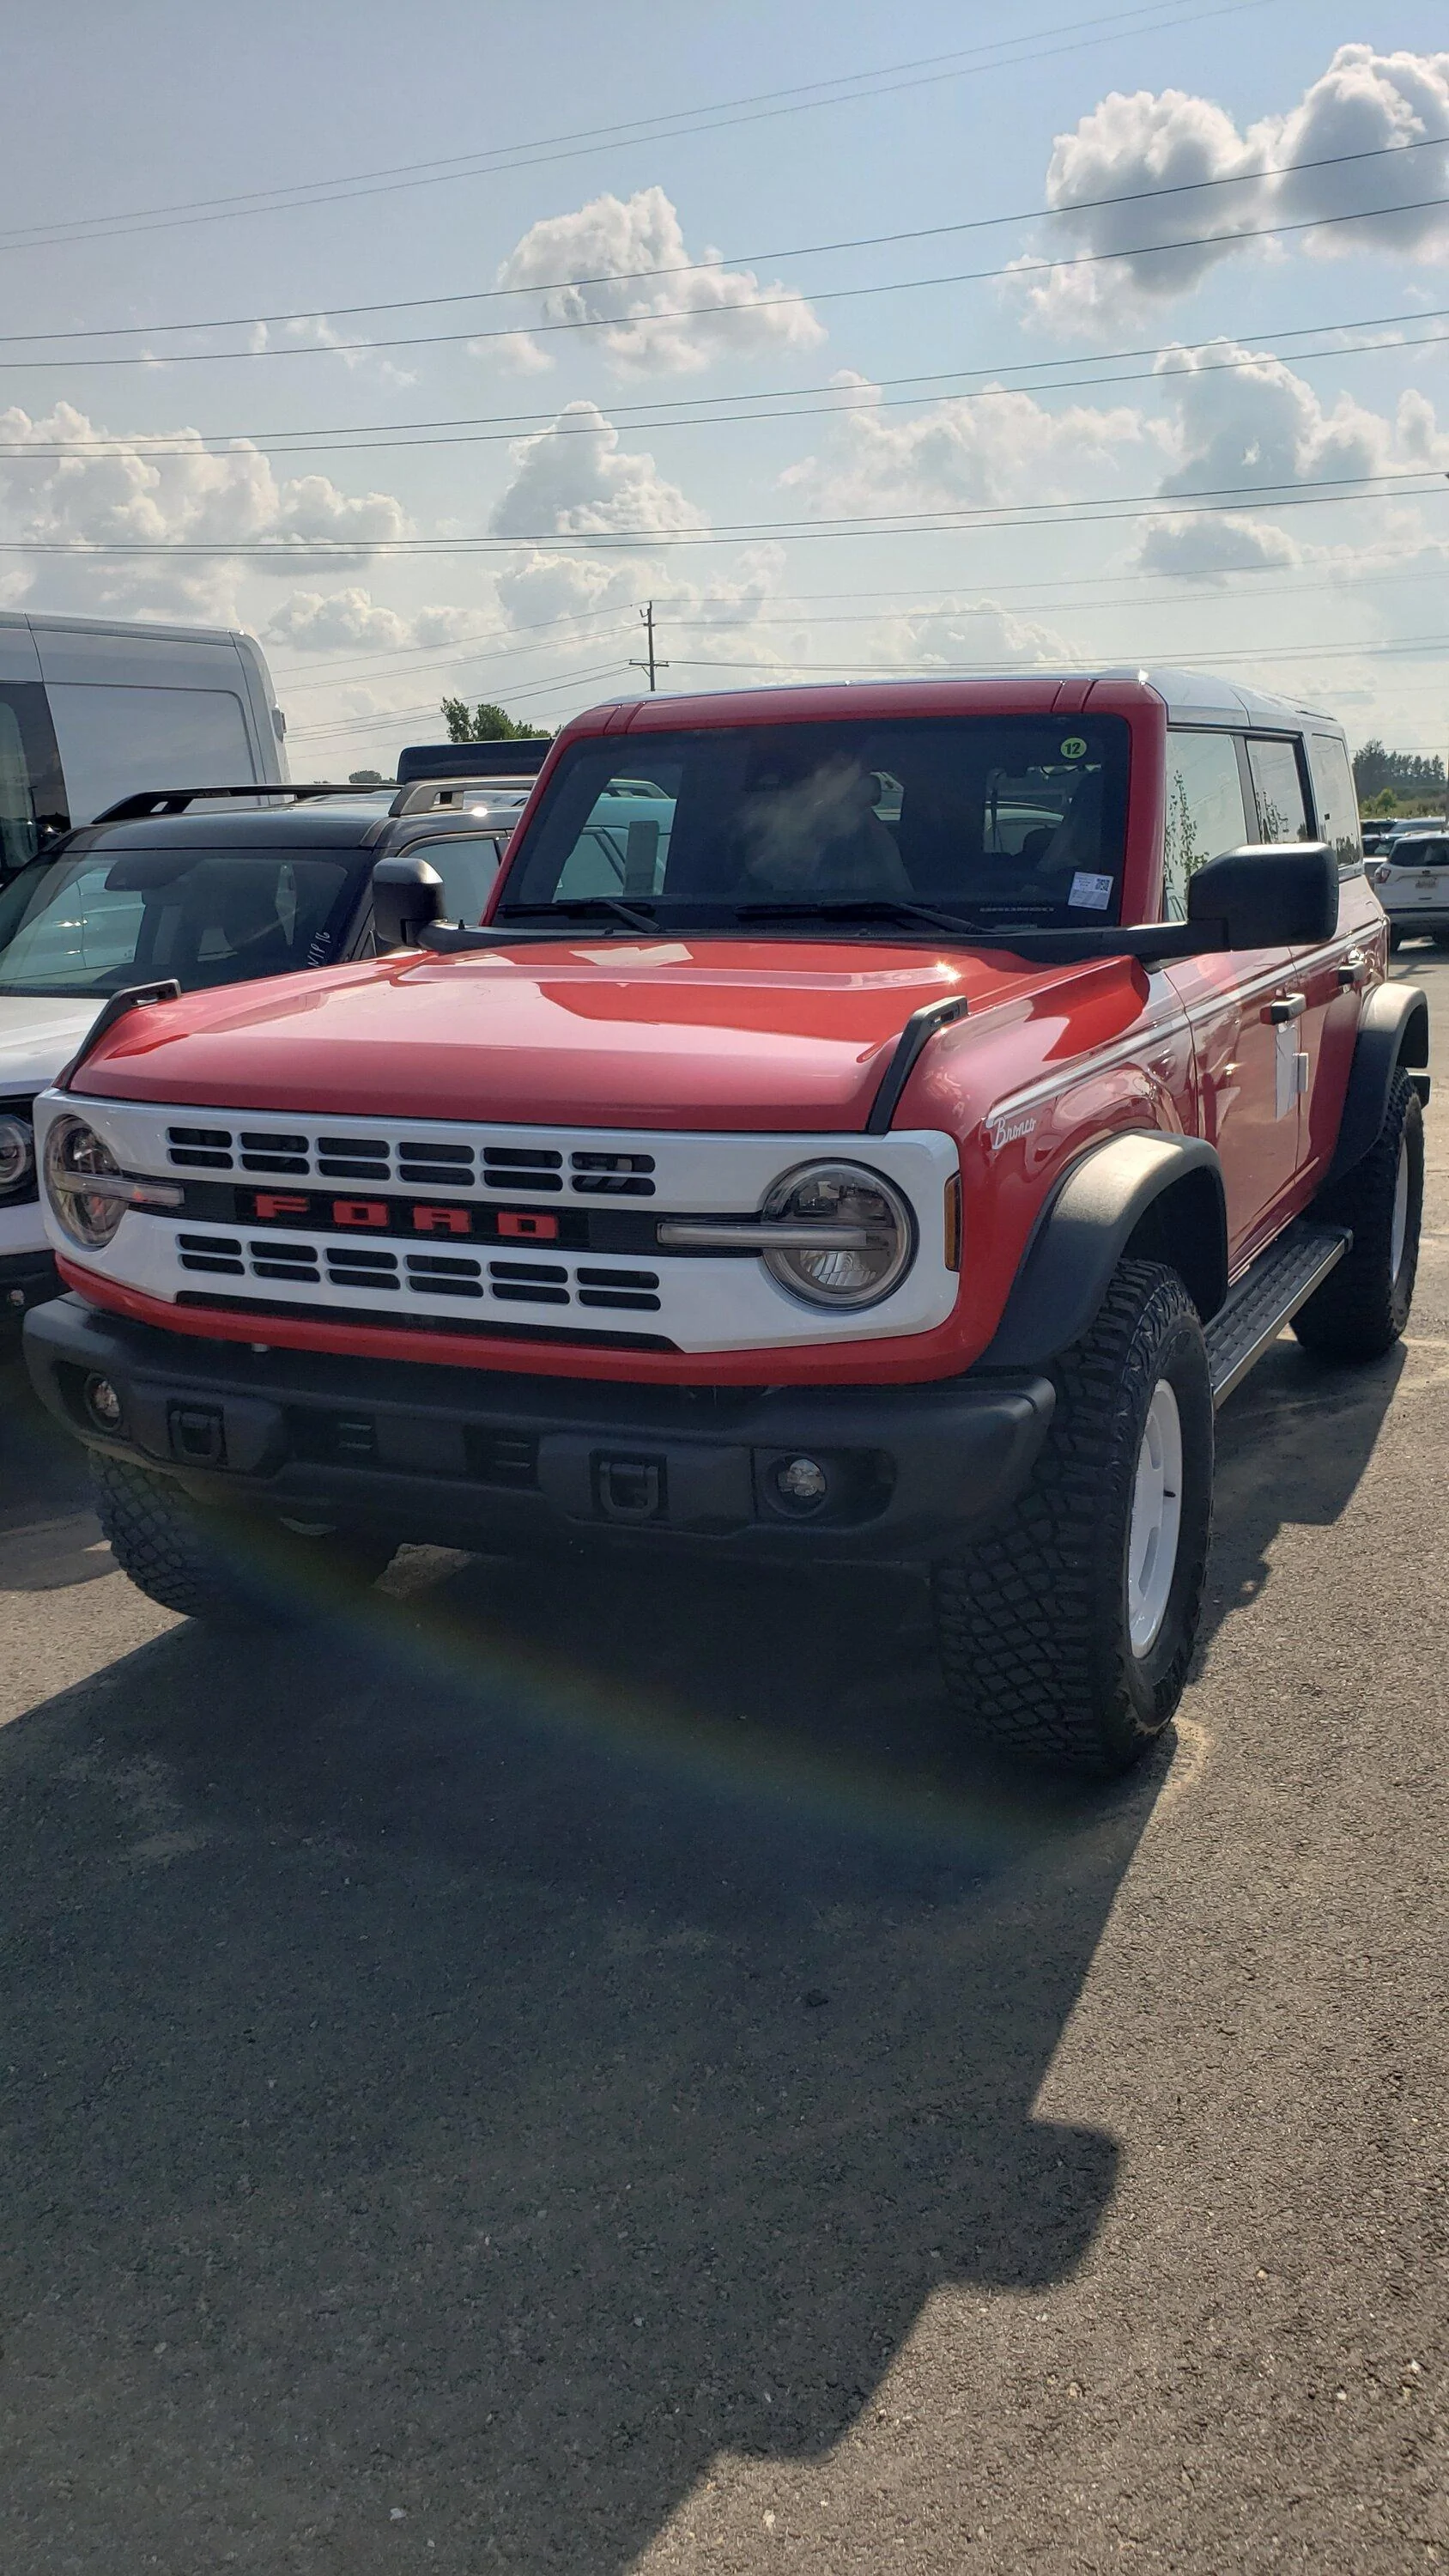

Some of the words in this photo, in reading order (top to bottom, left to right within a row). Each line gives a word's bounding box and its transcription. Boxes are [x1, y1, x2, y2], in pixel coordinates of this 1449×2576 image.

[1064, 742, 1081, 755] 12
[991, 1116, 1037, 1150] Bronco
[255, 1194, 558, 1239] FORD
